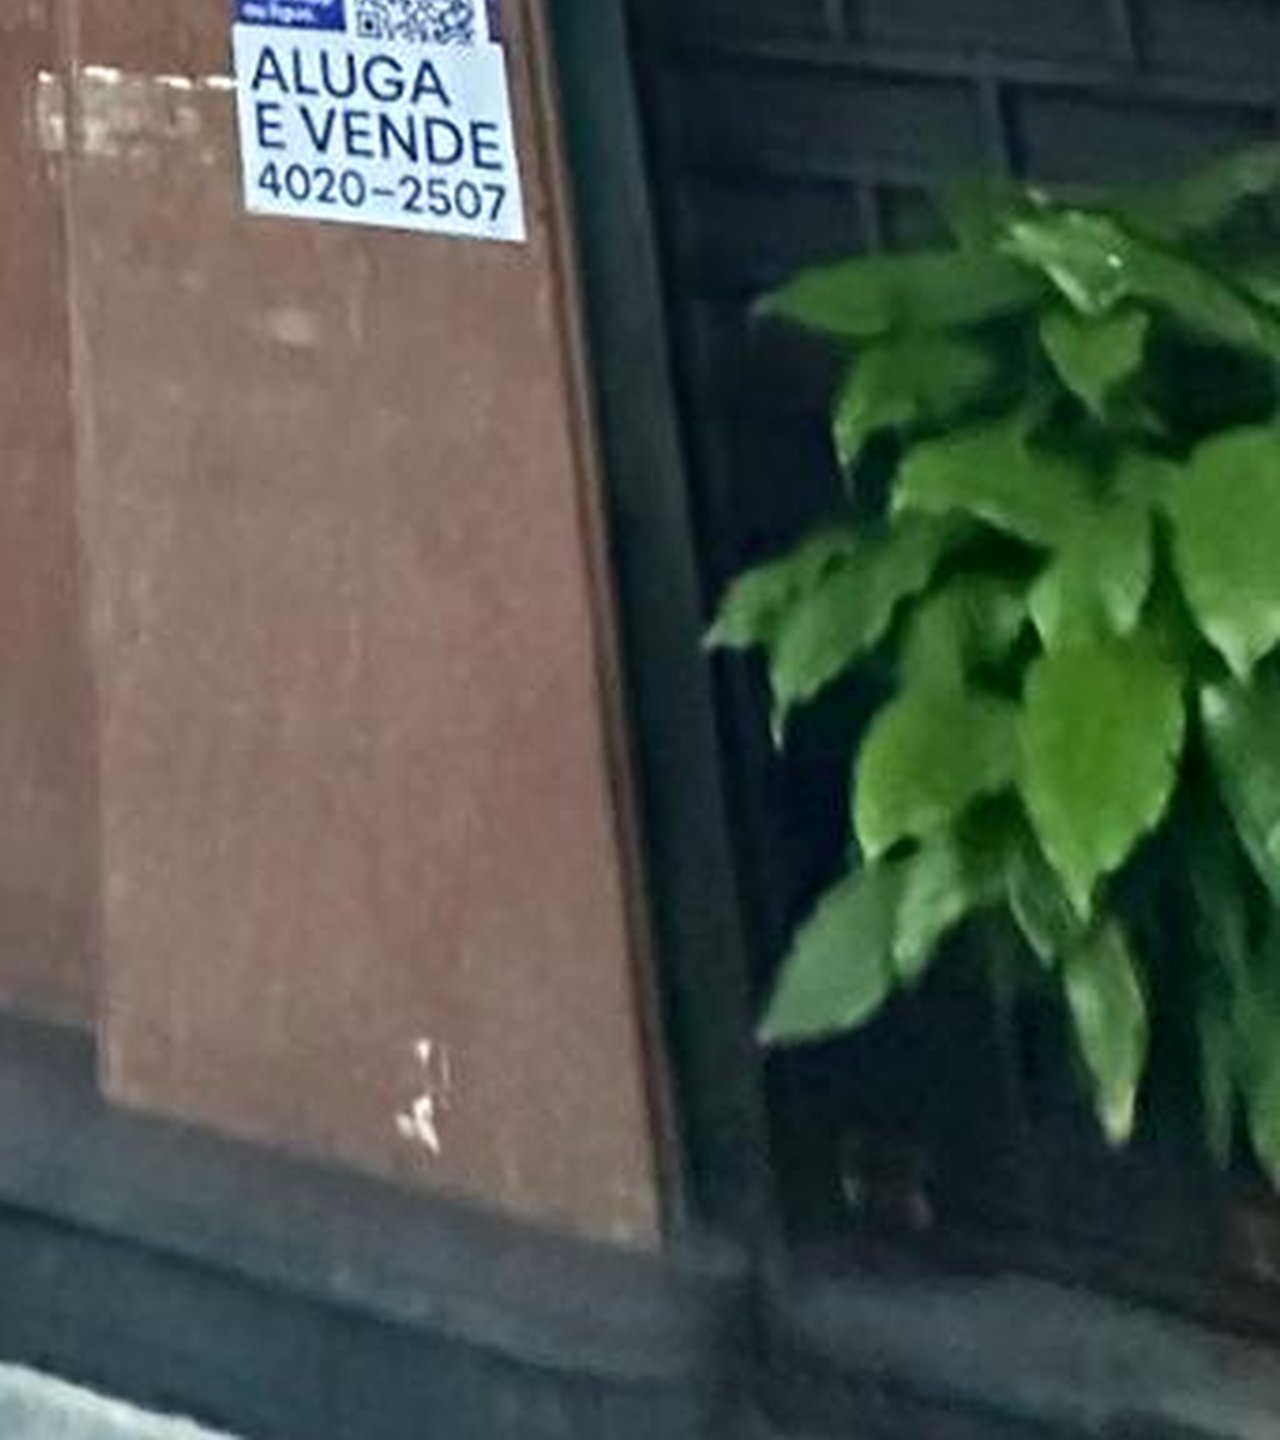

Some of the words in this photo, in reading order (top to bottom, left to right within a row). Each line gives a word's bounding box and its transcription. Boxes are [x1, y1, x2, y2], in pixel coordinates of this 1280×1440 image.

[250, 47, 453, 108] ALUGA
[255, 103, 287, 150] E
[300, 107, 504, 171] VENDE
[258, 162, 507, 221] 4020-2507
